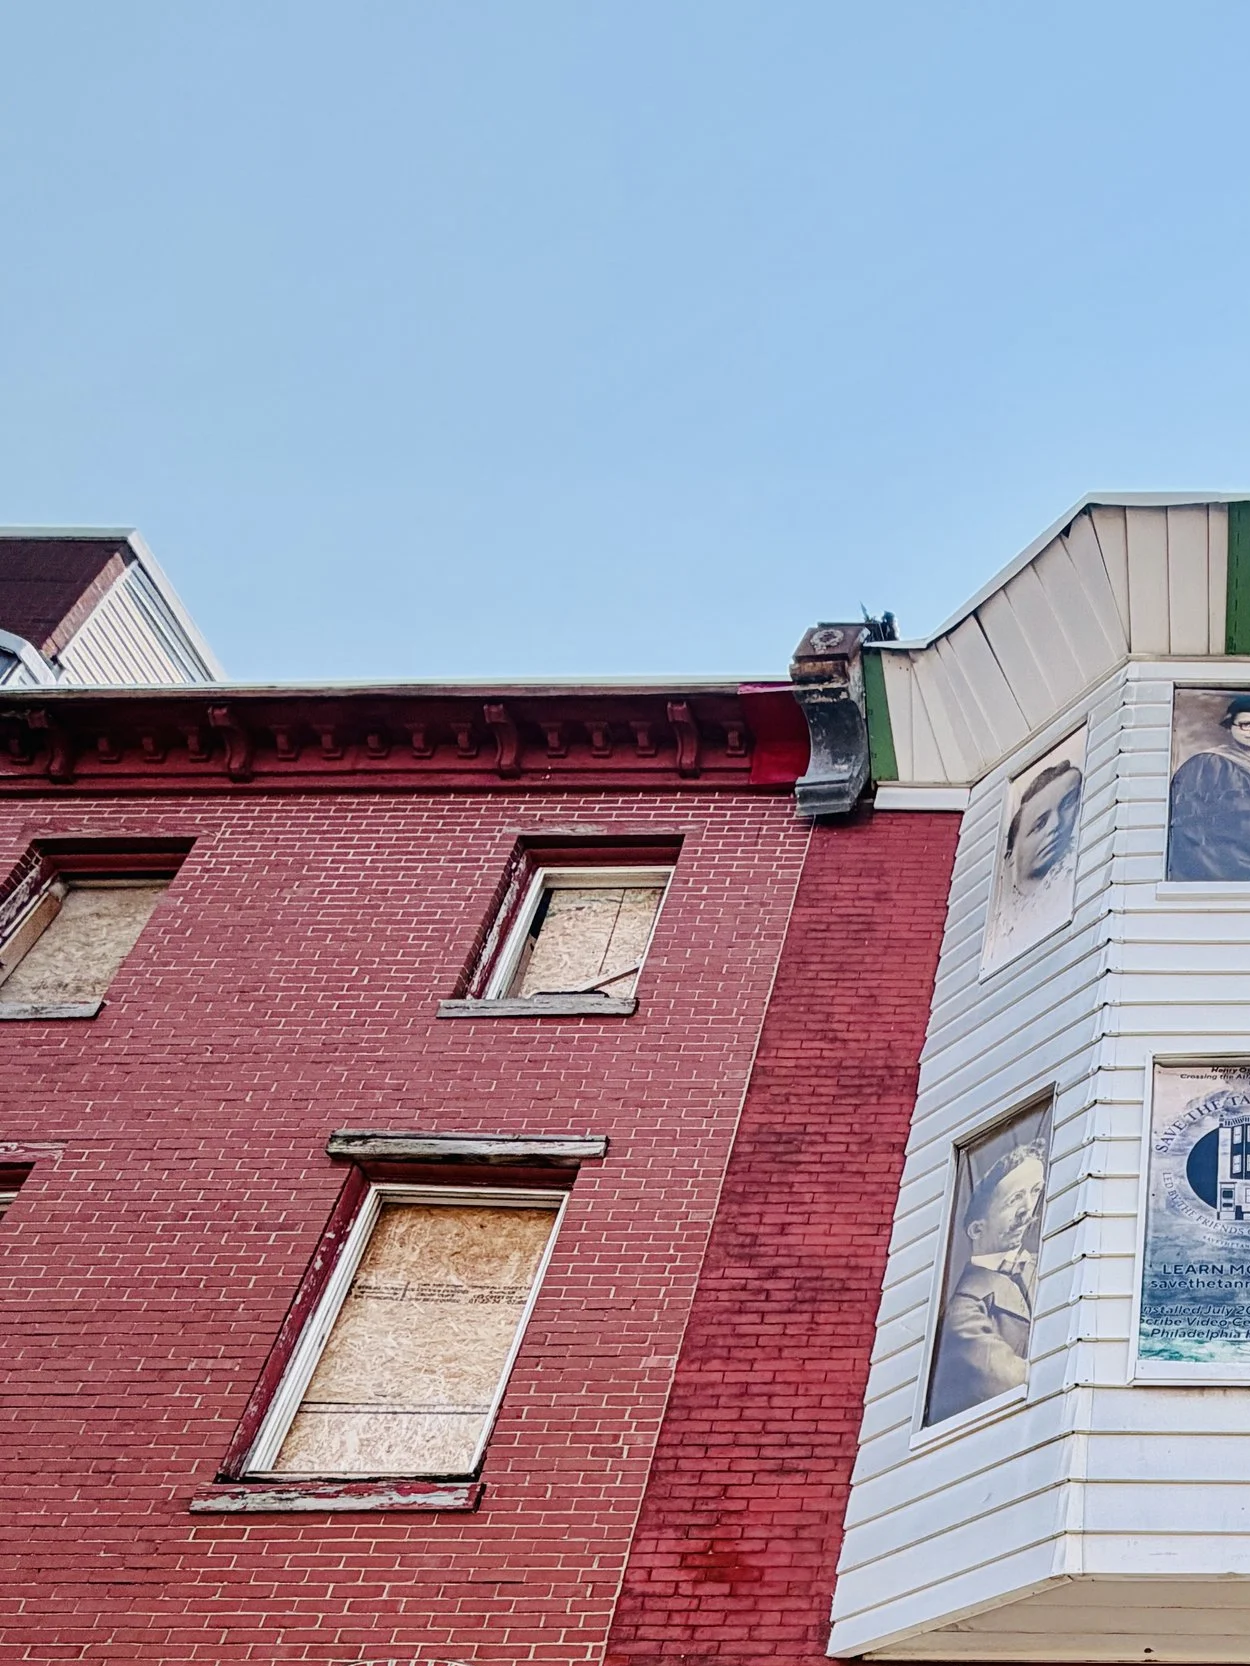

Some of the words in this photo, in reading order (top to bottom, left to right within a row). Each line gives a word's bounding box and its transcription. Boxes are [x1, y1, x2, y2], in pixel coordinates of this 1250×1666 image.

[1180, 1073, 1218, 1081] Crossing
[1155, 1120, 1187, 1153] SAVE
[1183, 1101, 1225, 1122] THE
[1162, 1171, 1174, 1190] LED
[1176, 1198, 1198, 1217] THE
[1196, 1214, 1245, 1236] FRIENDS
[1162, 1264, 1224, 1276] LEARN
[1142, 1304, 1200, 1316] nstalled
[1203, 1304, 1233, 1317] July
[1186, 1317, 1228, 1328] Video
[1150, 1329, 1242, 1341] Philadelphia
